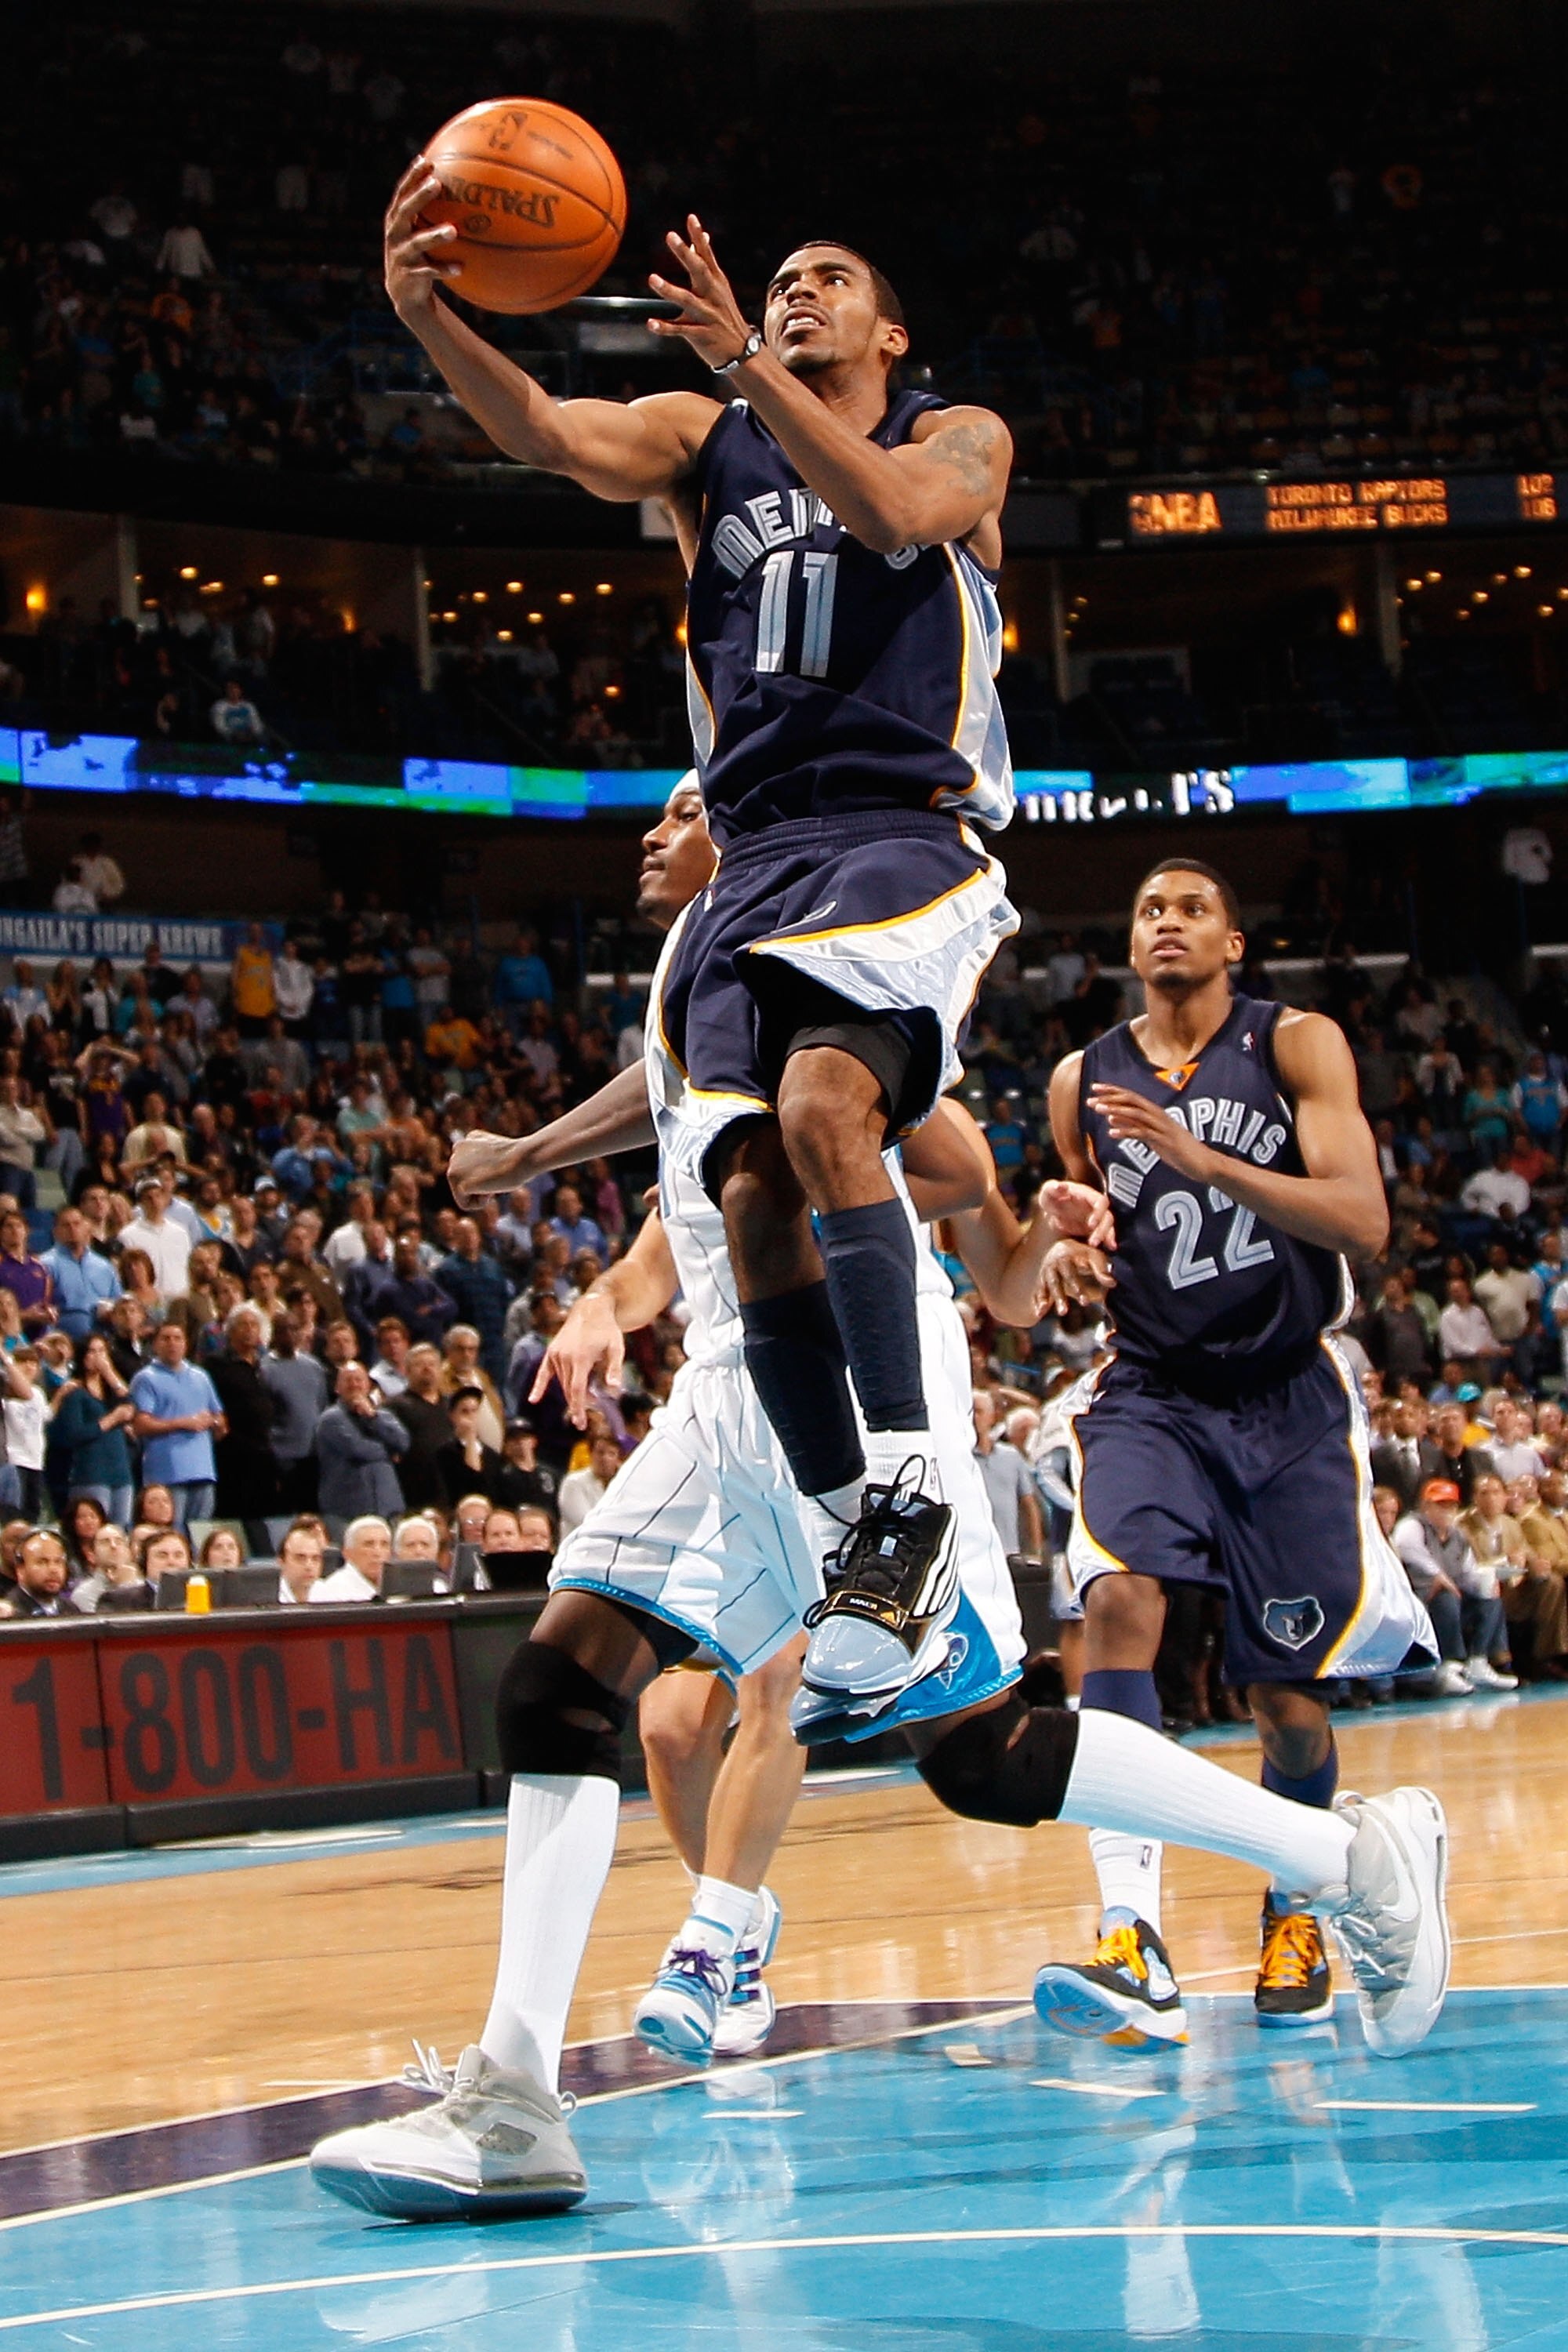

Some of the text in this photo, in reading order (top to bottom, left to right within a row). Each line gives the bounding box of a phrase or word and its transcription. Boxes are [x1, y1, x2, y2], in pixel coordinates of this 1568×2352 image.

[440, 176, 560, 227] SPALDIN
[1266, 482, 1353, 507] TORONTO
[1359, 478, 1446, 503] RAPTORS
[1266, 506, 1378, 532] MILWAUKEE
[1383, 503, 1448, 528] BUCKS
[711, 488, 931, 580] MEMS
[755, 550, 838, 677] 11
[0, 916, 86, 951] NGAILA'S
[93, 921, 153, 953] SUPER
[1155, 1186, 1275, 1290] 22
[12, 1635, 456, 1801] 1-800-HA
